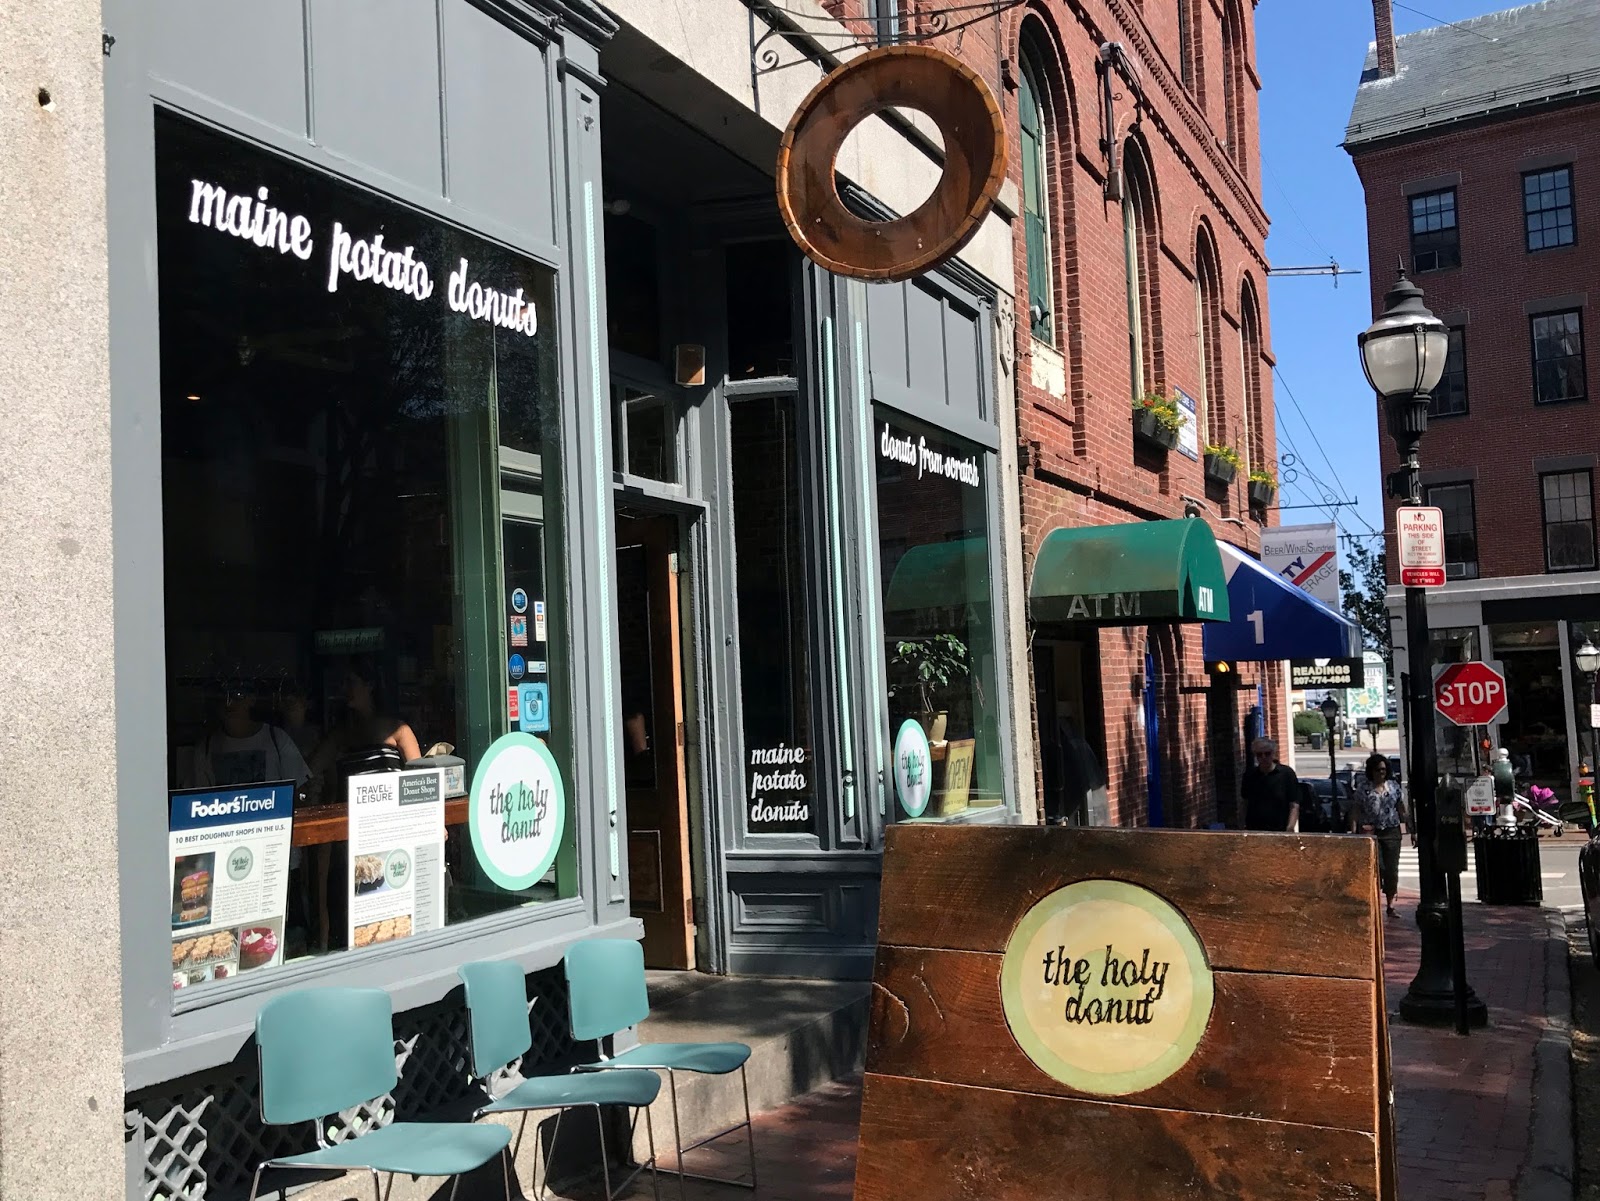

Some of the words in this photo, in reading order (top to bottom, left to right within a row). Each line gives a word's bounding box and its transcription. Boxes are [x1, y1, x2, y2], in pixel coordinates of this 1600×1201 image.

[188, 179, 313, 260] maine
[327, 222, 434, 301] potato
[448, 257, 538, 337] donuts
[881, 422, 917, 467] donuts
[918, 436, 944, 480] from
[944, 455, 980, 487] scratch
[1403, 523, 1438, 532] PARKING
[1413, 513, 1426, 522] NO
[1279, 556, 1306, 579] TY
[1066, 592, 1141, 620] ATM
[1198, 586, 1214, 614] ATM
[1246, 610, 1265, 645] 1
[1292, 664, 1351, 676] READINGS
[1439, 680, 1501, 708] STOP
[750, 742, 805, 765] maine
[401, 777, 426, 788] America's
[426, 776, 438, 785] Best
[750, 768, 807, 799] potato
[949, 755, 971, 793] OPEN
[356, 792, 394, 805] LEISURE
[403, 786, 420, 796] Donut
[420, 785, 436, 796] Shops
[490, 783, 514, 815] the
[518, 780, 549, 820] holy
[750, 797, 809, 823] donuts
[175, 836, 184, 844] 10
[184, 835, 199, 843] BEST
[199, 830, 235, 841] DOUGHNUT
[235, 828, 255, 837] SHOPS
[501, 808, 543, 843] donut
[1042, 945, 1092, 987] the
[1099, 944, 1171, 1001] holy
[1065, 984, 1156, 1026] donut
